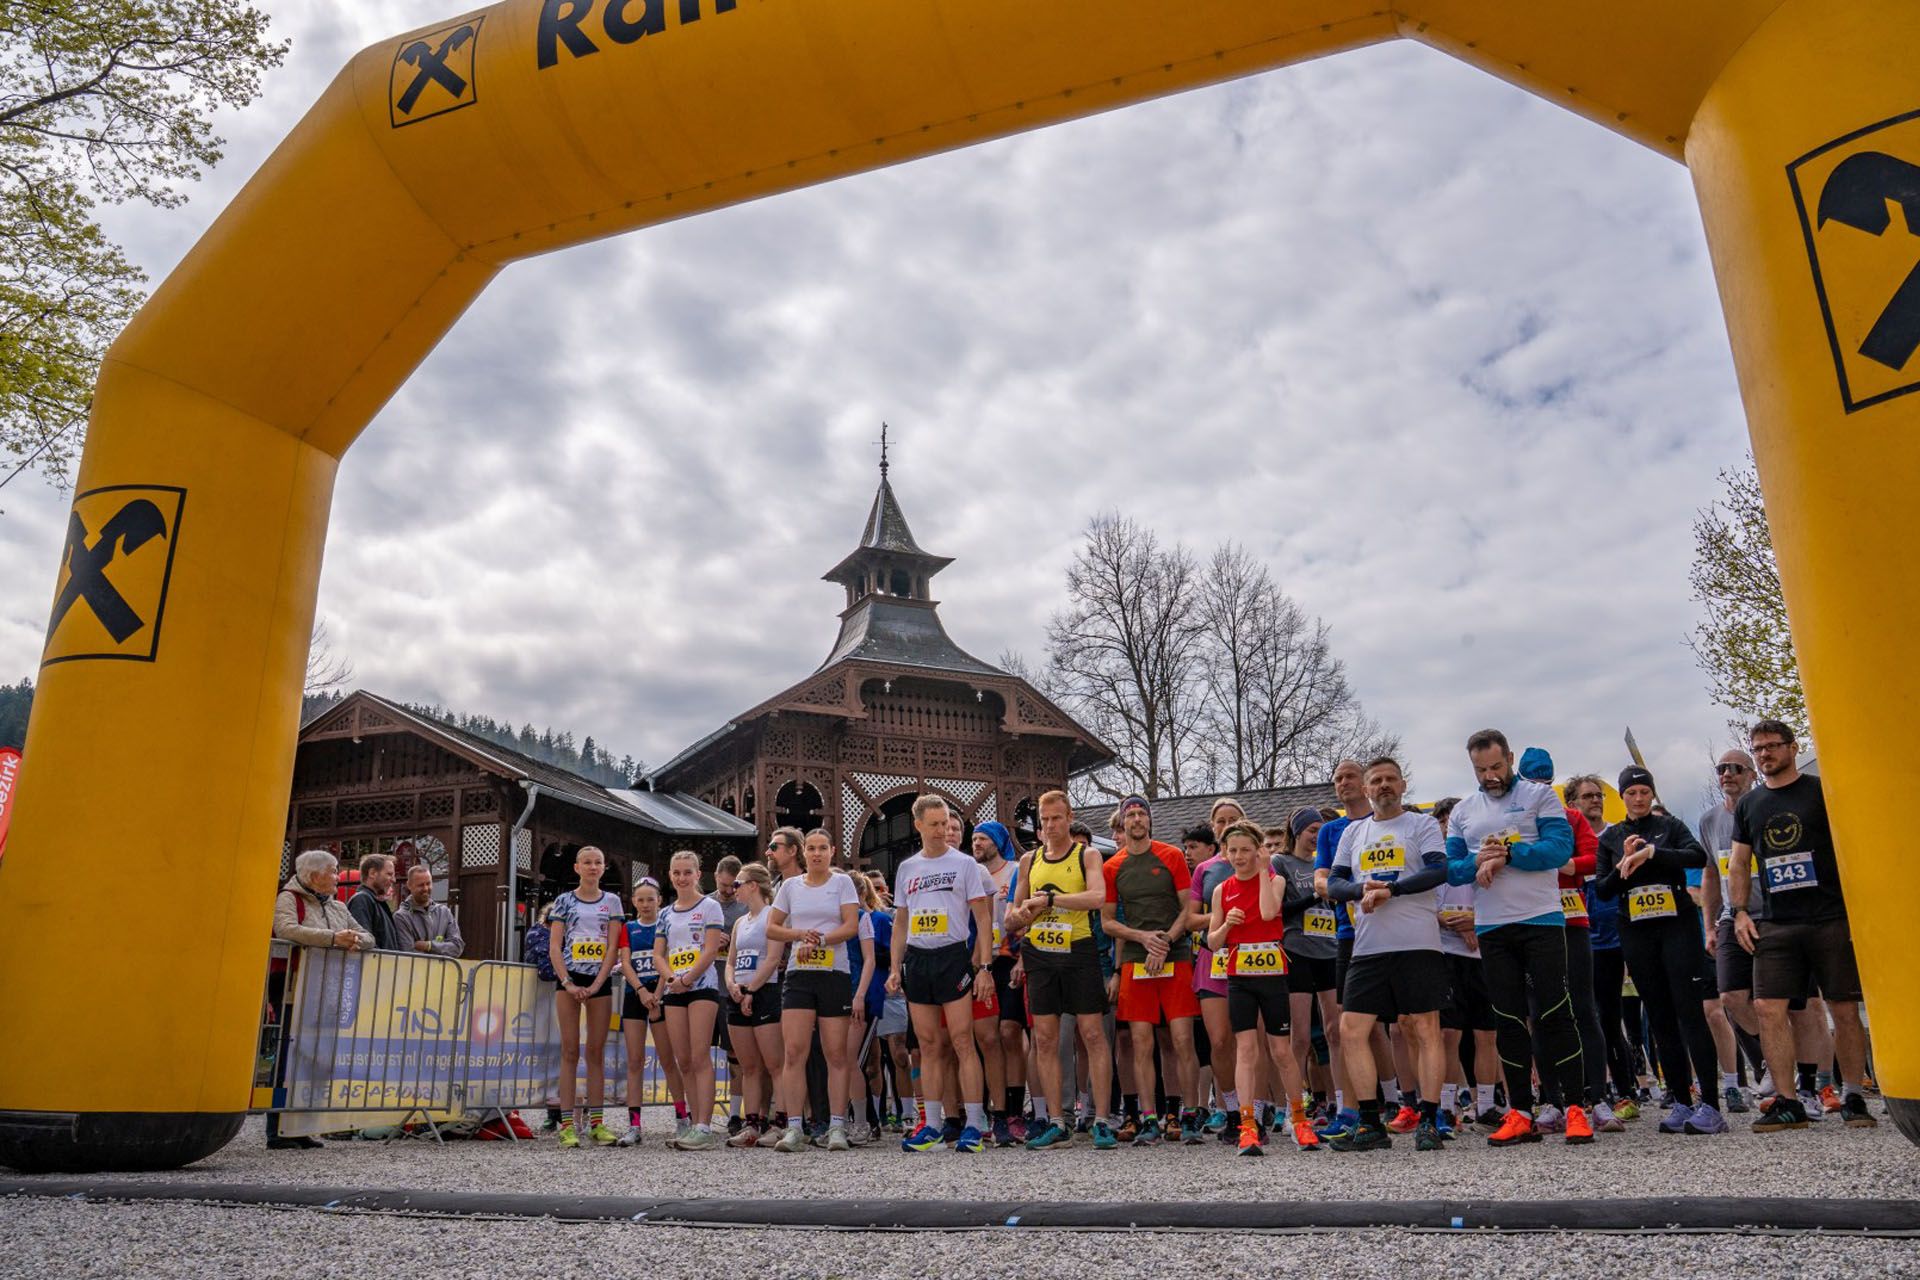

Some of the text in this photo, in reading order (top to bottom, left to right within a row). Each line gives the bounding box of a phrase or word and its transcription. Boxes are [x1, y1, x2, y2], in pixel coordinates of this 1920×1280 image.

[1367, 849, 1395, 862] 404
[1772, 864, 1807, 883] 343
[1636, 893, 1665, 906] 405
[918, 916, 938, 927] 419
[1311, 917, 1333, 931] 472
[1037, 931, 1064, 945] 456
[578, 944, 602, 956] 466
[811, 949, 826, 960] 33
[672, 952, 695, 967] 459
[1244, 953, 1276, 967] 460
